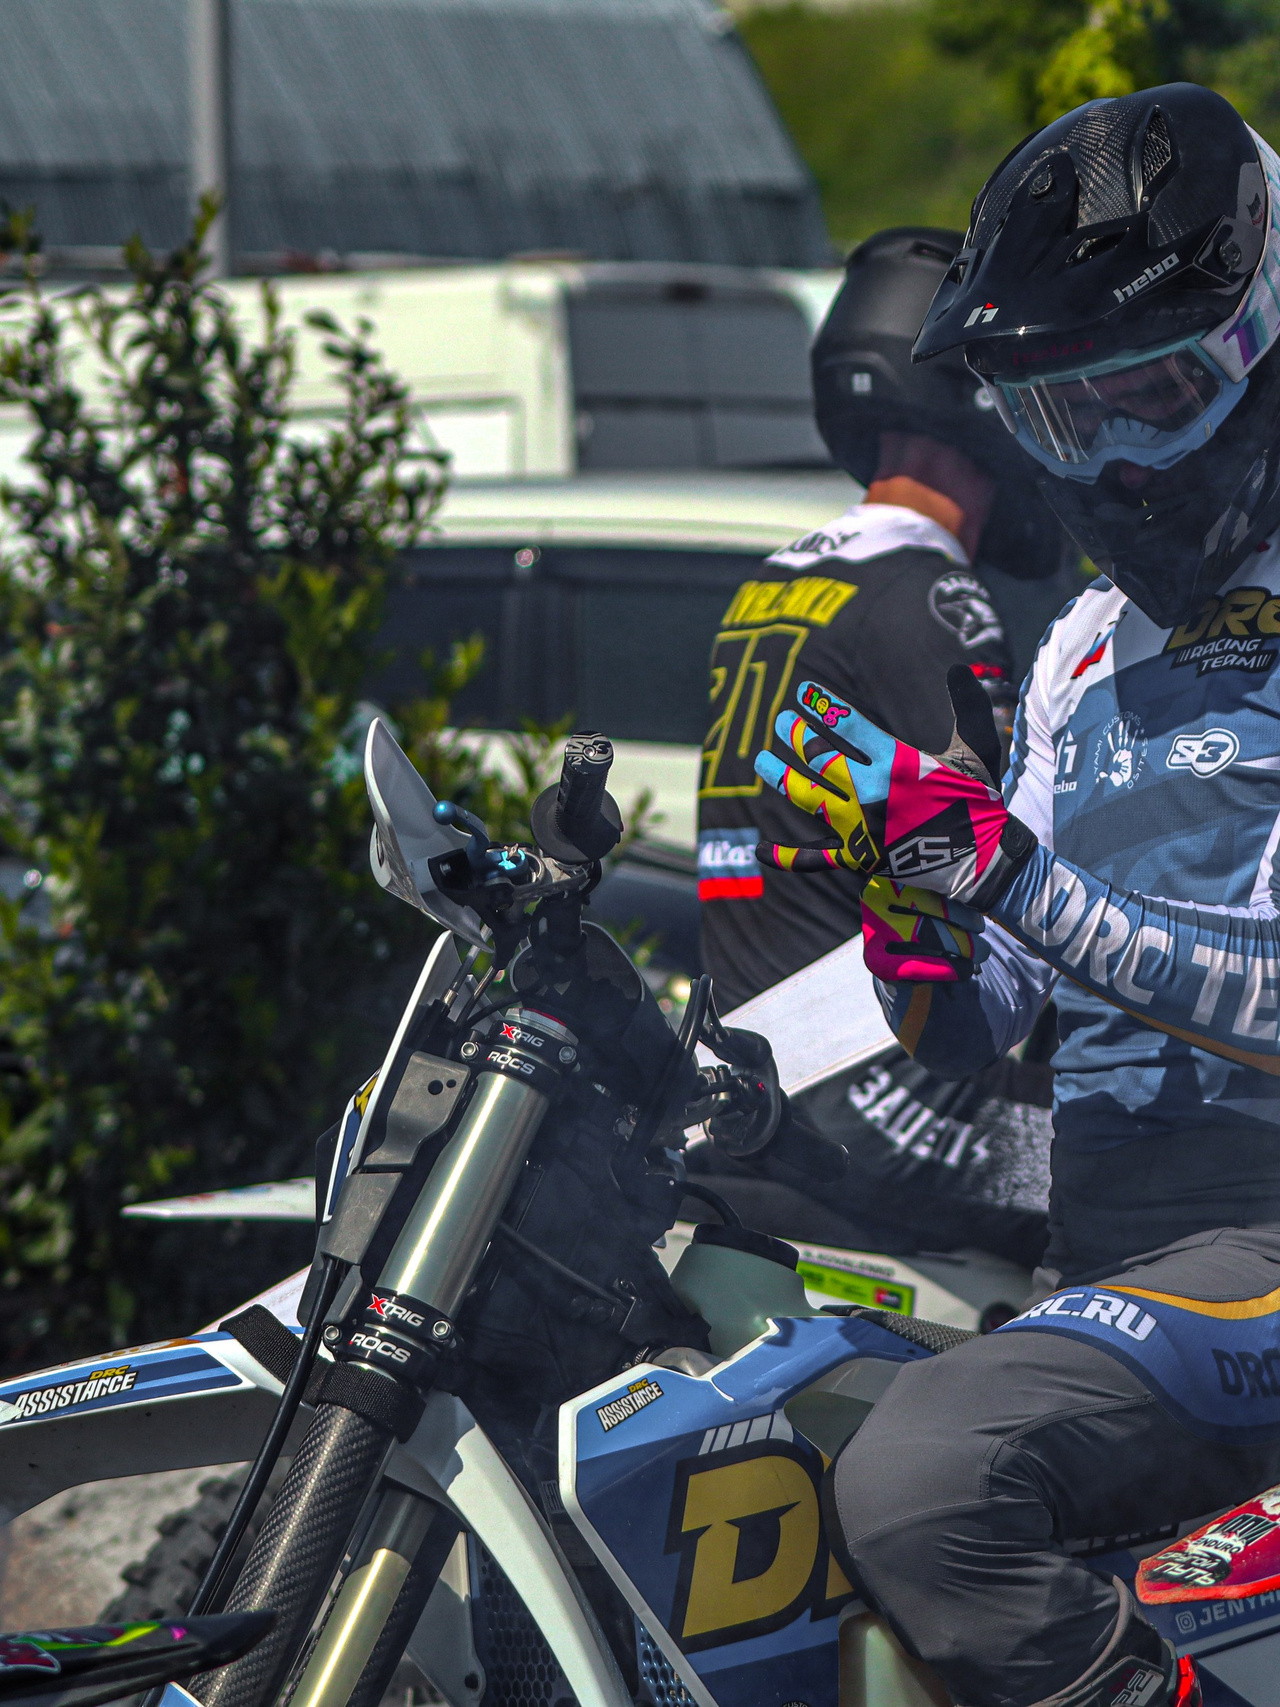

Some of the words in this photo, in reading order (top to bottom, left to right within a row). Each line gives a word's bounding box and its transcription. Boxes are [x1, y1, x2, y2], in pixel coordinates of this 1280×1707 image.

[1113, 253, 1180, 304] hebo
[1189, 637, 1262, 660] RACING
[1201, 652, 1257, 672] TEAM
[1102, 710, 1142, 737] CUSTOMS
[1053, 781, 1078, 795] ebo
[1017, 861, 1174, 1006] DRC
[499, 1022, 546, 1048] XTRIG
[486, 1051, 536, 1076] ROCS
[365, 1292, 426, 1328] XTRIG
[348, 1332, 412, 1363] ROCS
[89, 1365, 131, 1381] DRC
[628, 1378, 649, 1394] DRC
[1193, 1536, 1242, 1555] ENDURO
[1152, 1561, 1217, 1587] ПУТЬ
